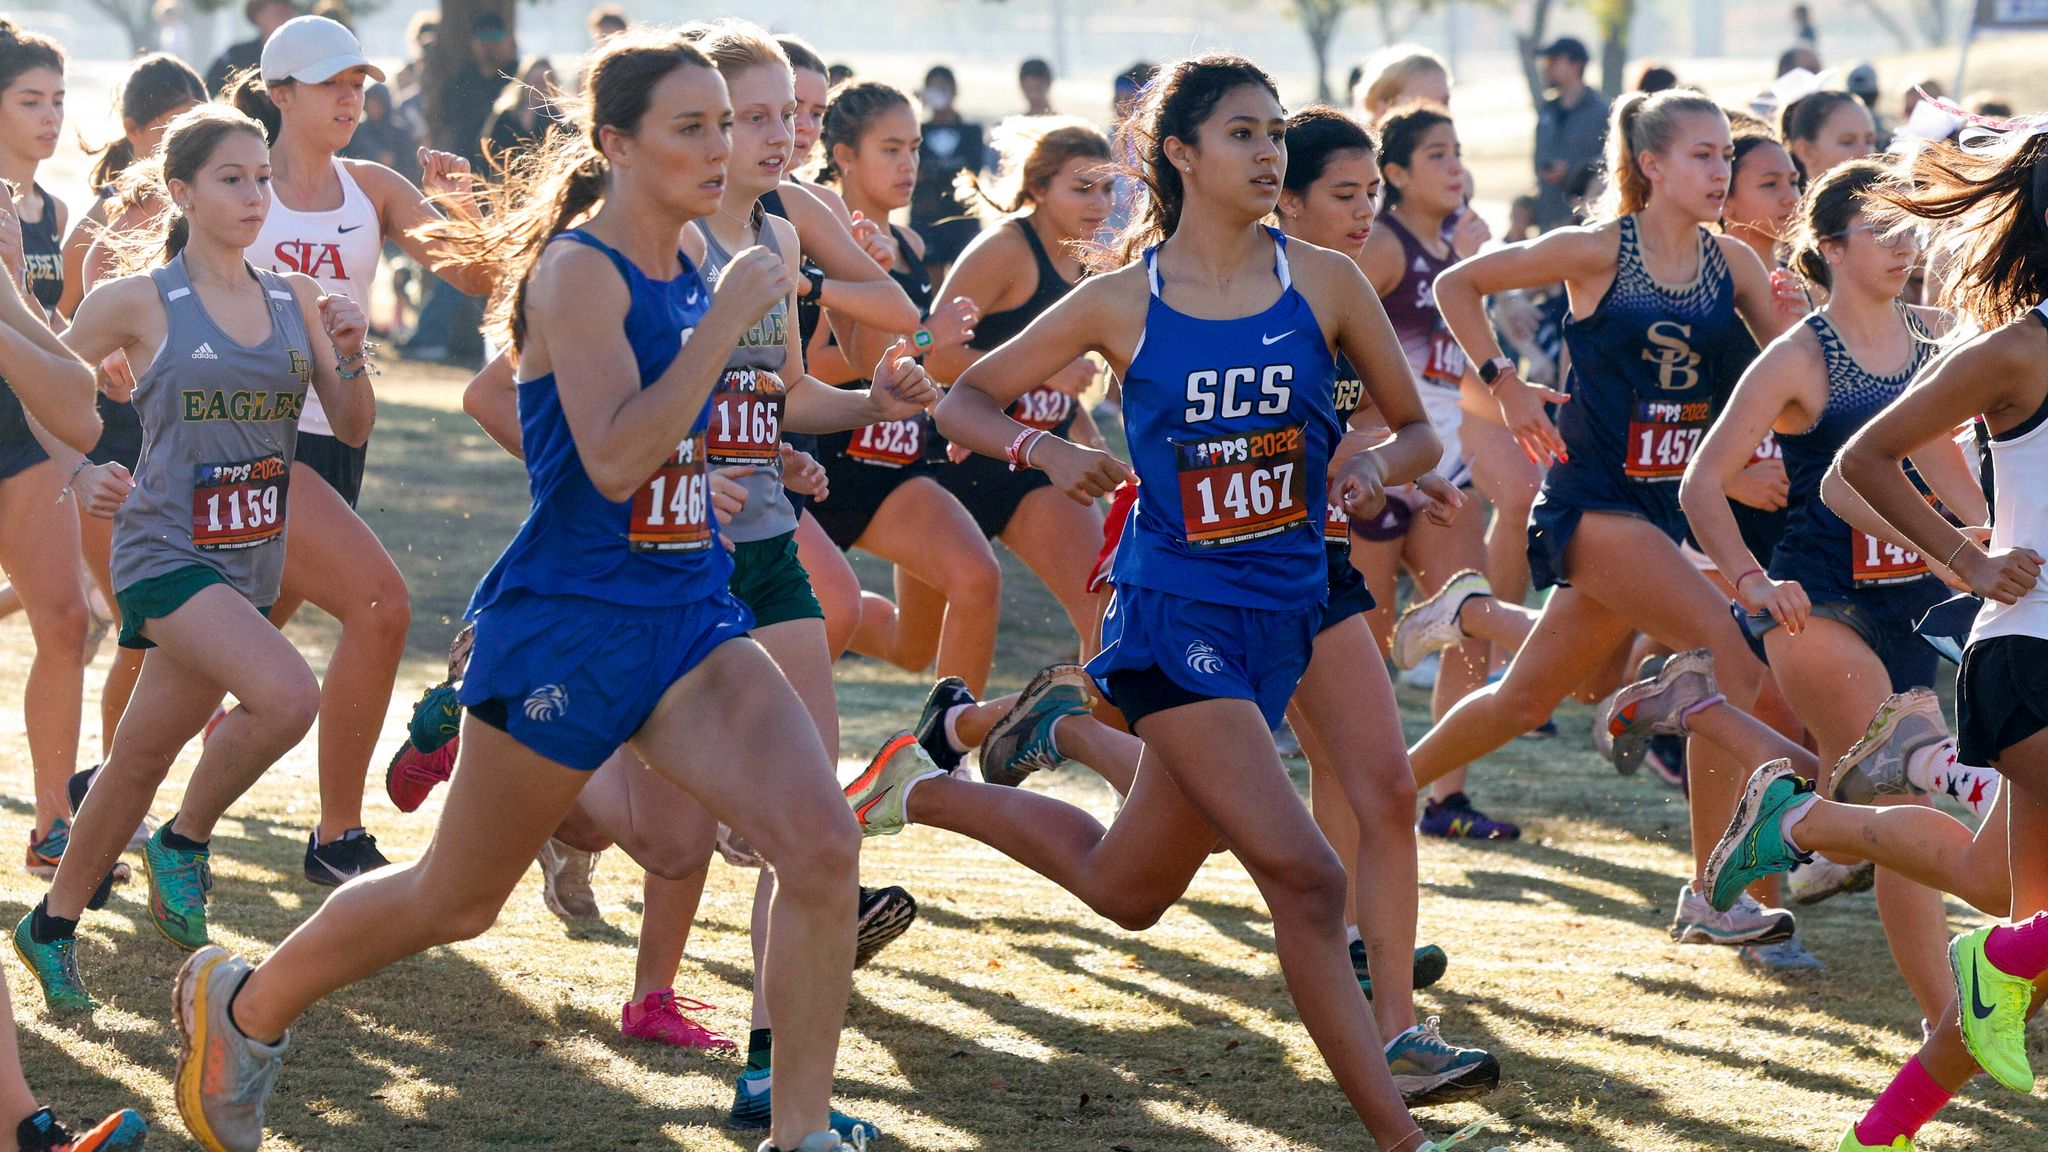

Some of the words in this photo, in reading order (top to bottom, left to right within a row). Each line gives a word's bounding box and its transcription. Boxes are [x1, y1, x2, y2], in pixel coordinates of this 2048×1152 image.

[191, 351, 218, 360] adidas
[1185, 364, 1293, 423] SCS
[1680, 402, 1710, 421] 2022
[717, 400, 778, 444] 1165
[859, 420, 920, 455] 1323
[1183, 437, 1248, 468] TAPPS
[1249, 428, 1298, 458] 2022
[1638, 428, 1702, 466] 1457
[250, 456, 285, 480] 2022
[207, 485, 278, 532] 1159
[1196, 462, 1294, 524] 1467
